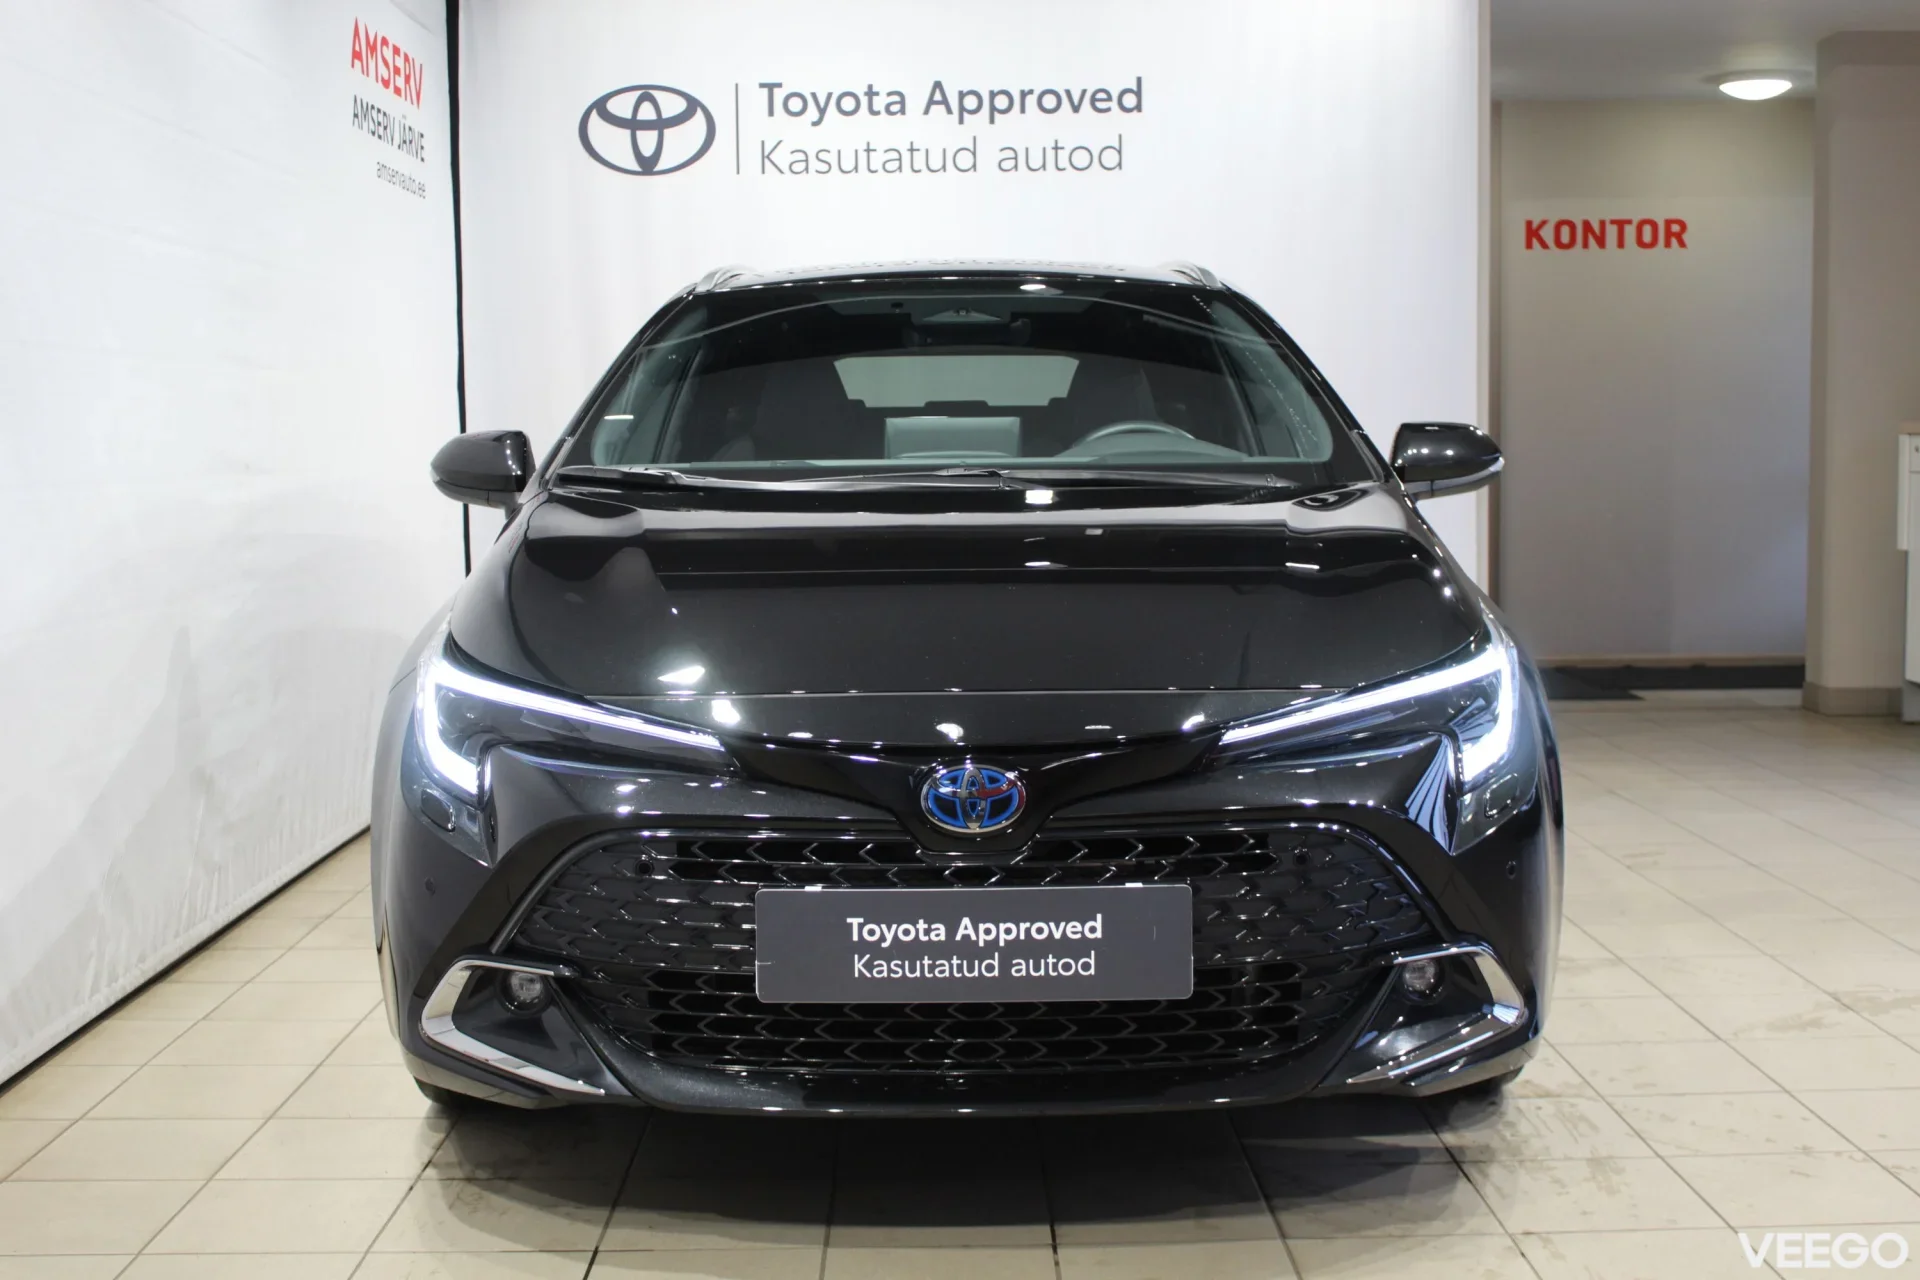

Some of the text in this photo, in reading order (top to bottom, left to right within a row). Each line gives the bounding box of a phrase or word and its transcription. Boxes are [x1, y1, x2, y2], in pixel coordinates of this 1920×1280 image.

[351, 16, 423, 109] AMSERV
[759, 76, 1143, 127] Toyota Approved
[352, 94, 425, 162] AMSERV JÄRVE
[759, 133, 1125, 176] Kasutatud autod
[376, 161, 426, 199] amservauto.ee
[1524, 217, 1689, 251] KONTOR
[846, 913, 1102, 947] Toyota Approved
[853, 950, 1097, 979] Kasutatud autod
